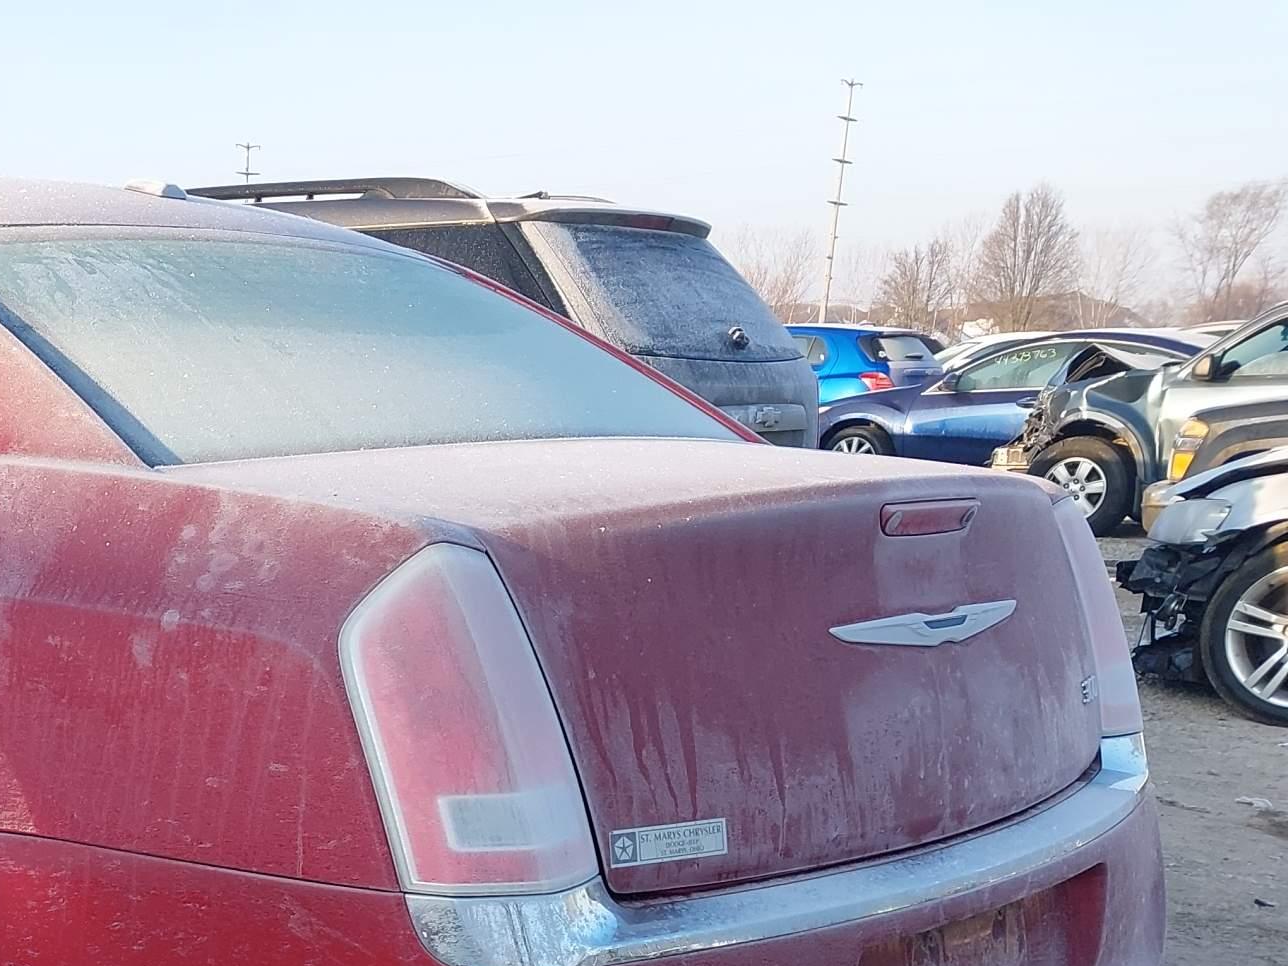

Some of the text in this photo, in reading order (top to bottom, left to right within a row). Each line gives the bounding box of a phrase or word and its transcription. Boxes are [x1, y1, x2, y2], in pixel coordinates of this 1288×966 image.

[640, 824, 721, 843] ST. MARYS CHRYSLER
